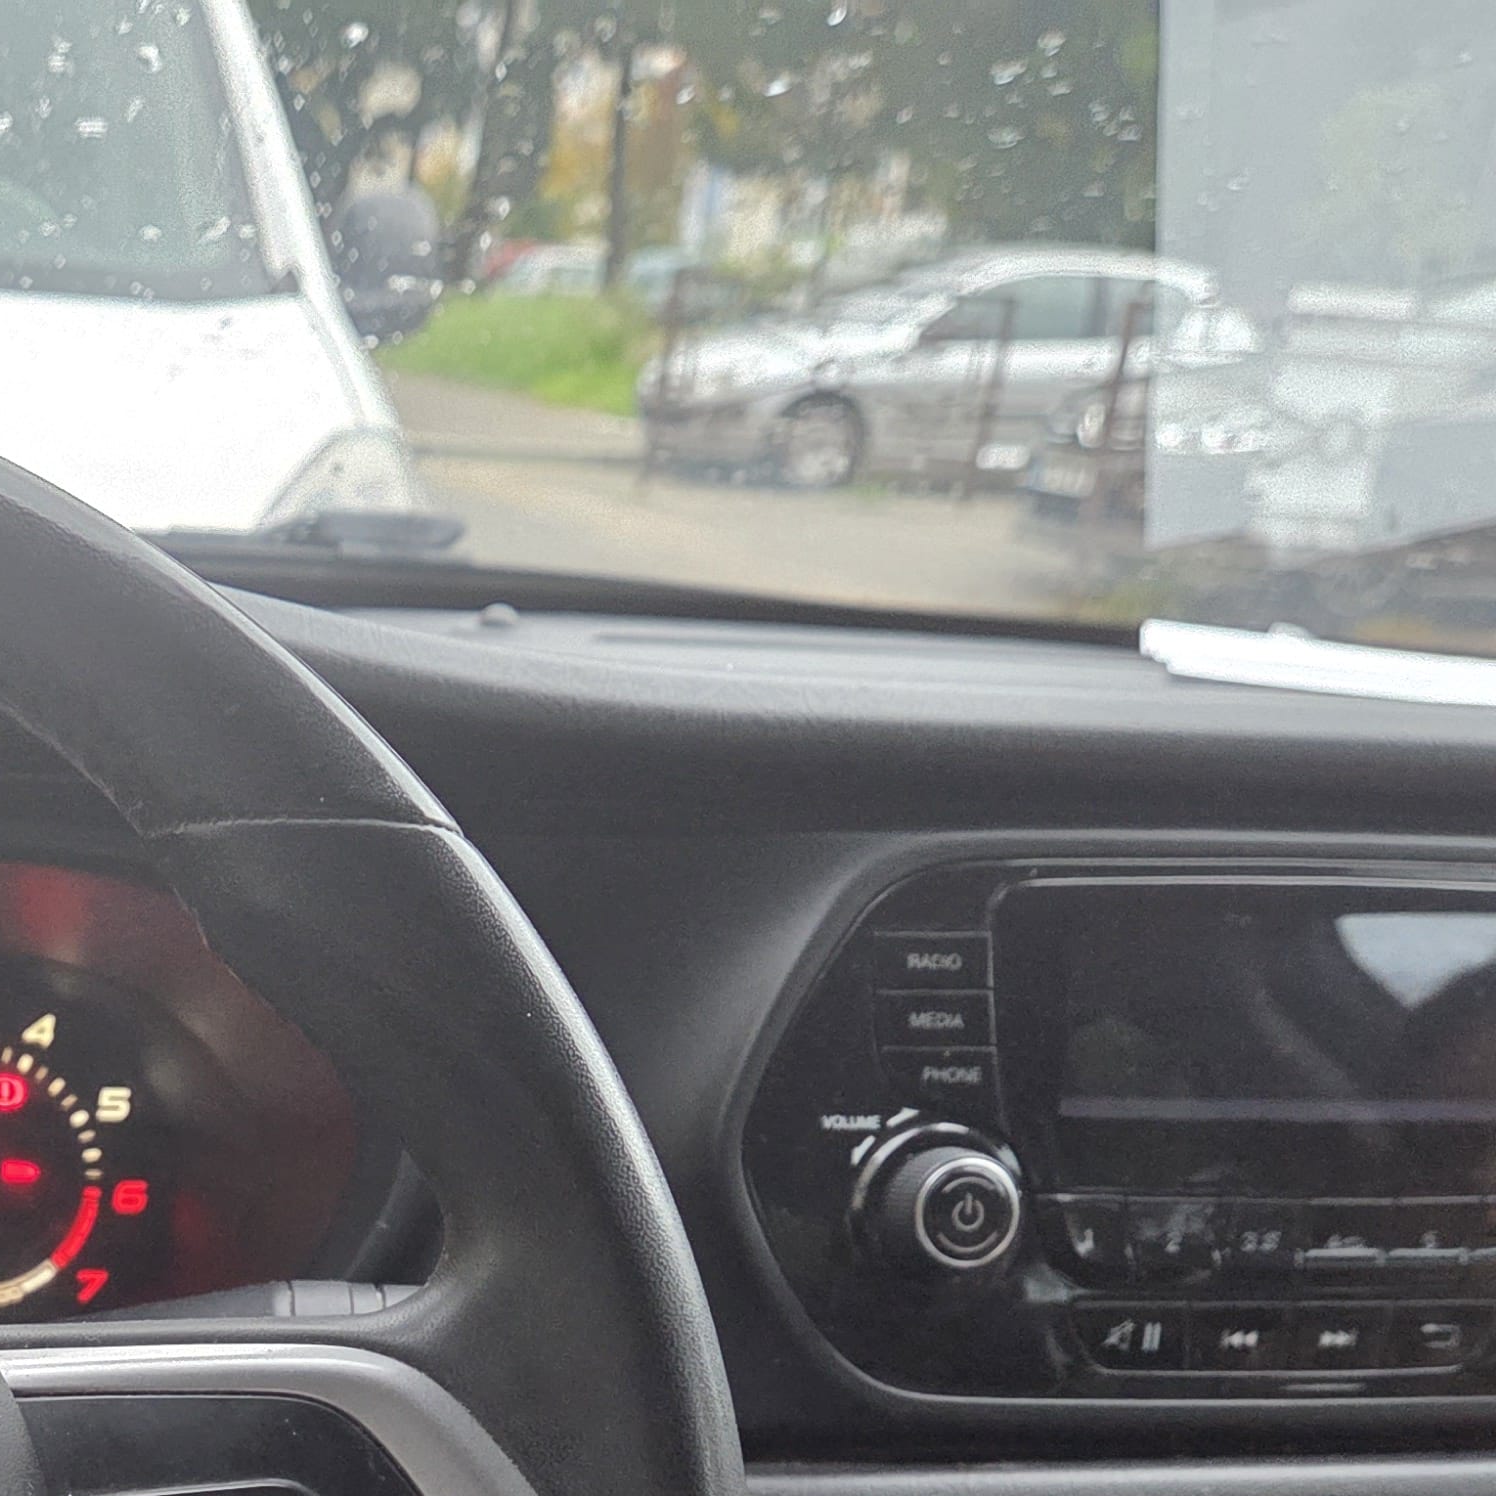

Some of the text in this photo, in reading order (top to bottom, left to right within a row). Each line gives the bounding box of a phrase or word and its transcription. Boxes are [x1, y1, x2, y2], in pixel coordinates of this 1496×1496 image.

[906, 953, 962, 970] RADIO
[21, 1014, 56, 1048] 4
[908, 1010, 965, 1029] MEDIA
[921, 1066, 982, 1084] PHONE
[95, 1086, 132, 1122] 5
[821, 1114, 881, 1131] VOLUME
[111, 1179, 148, 1215] 6
[76, 1268, 109, 1303] 7
